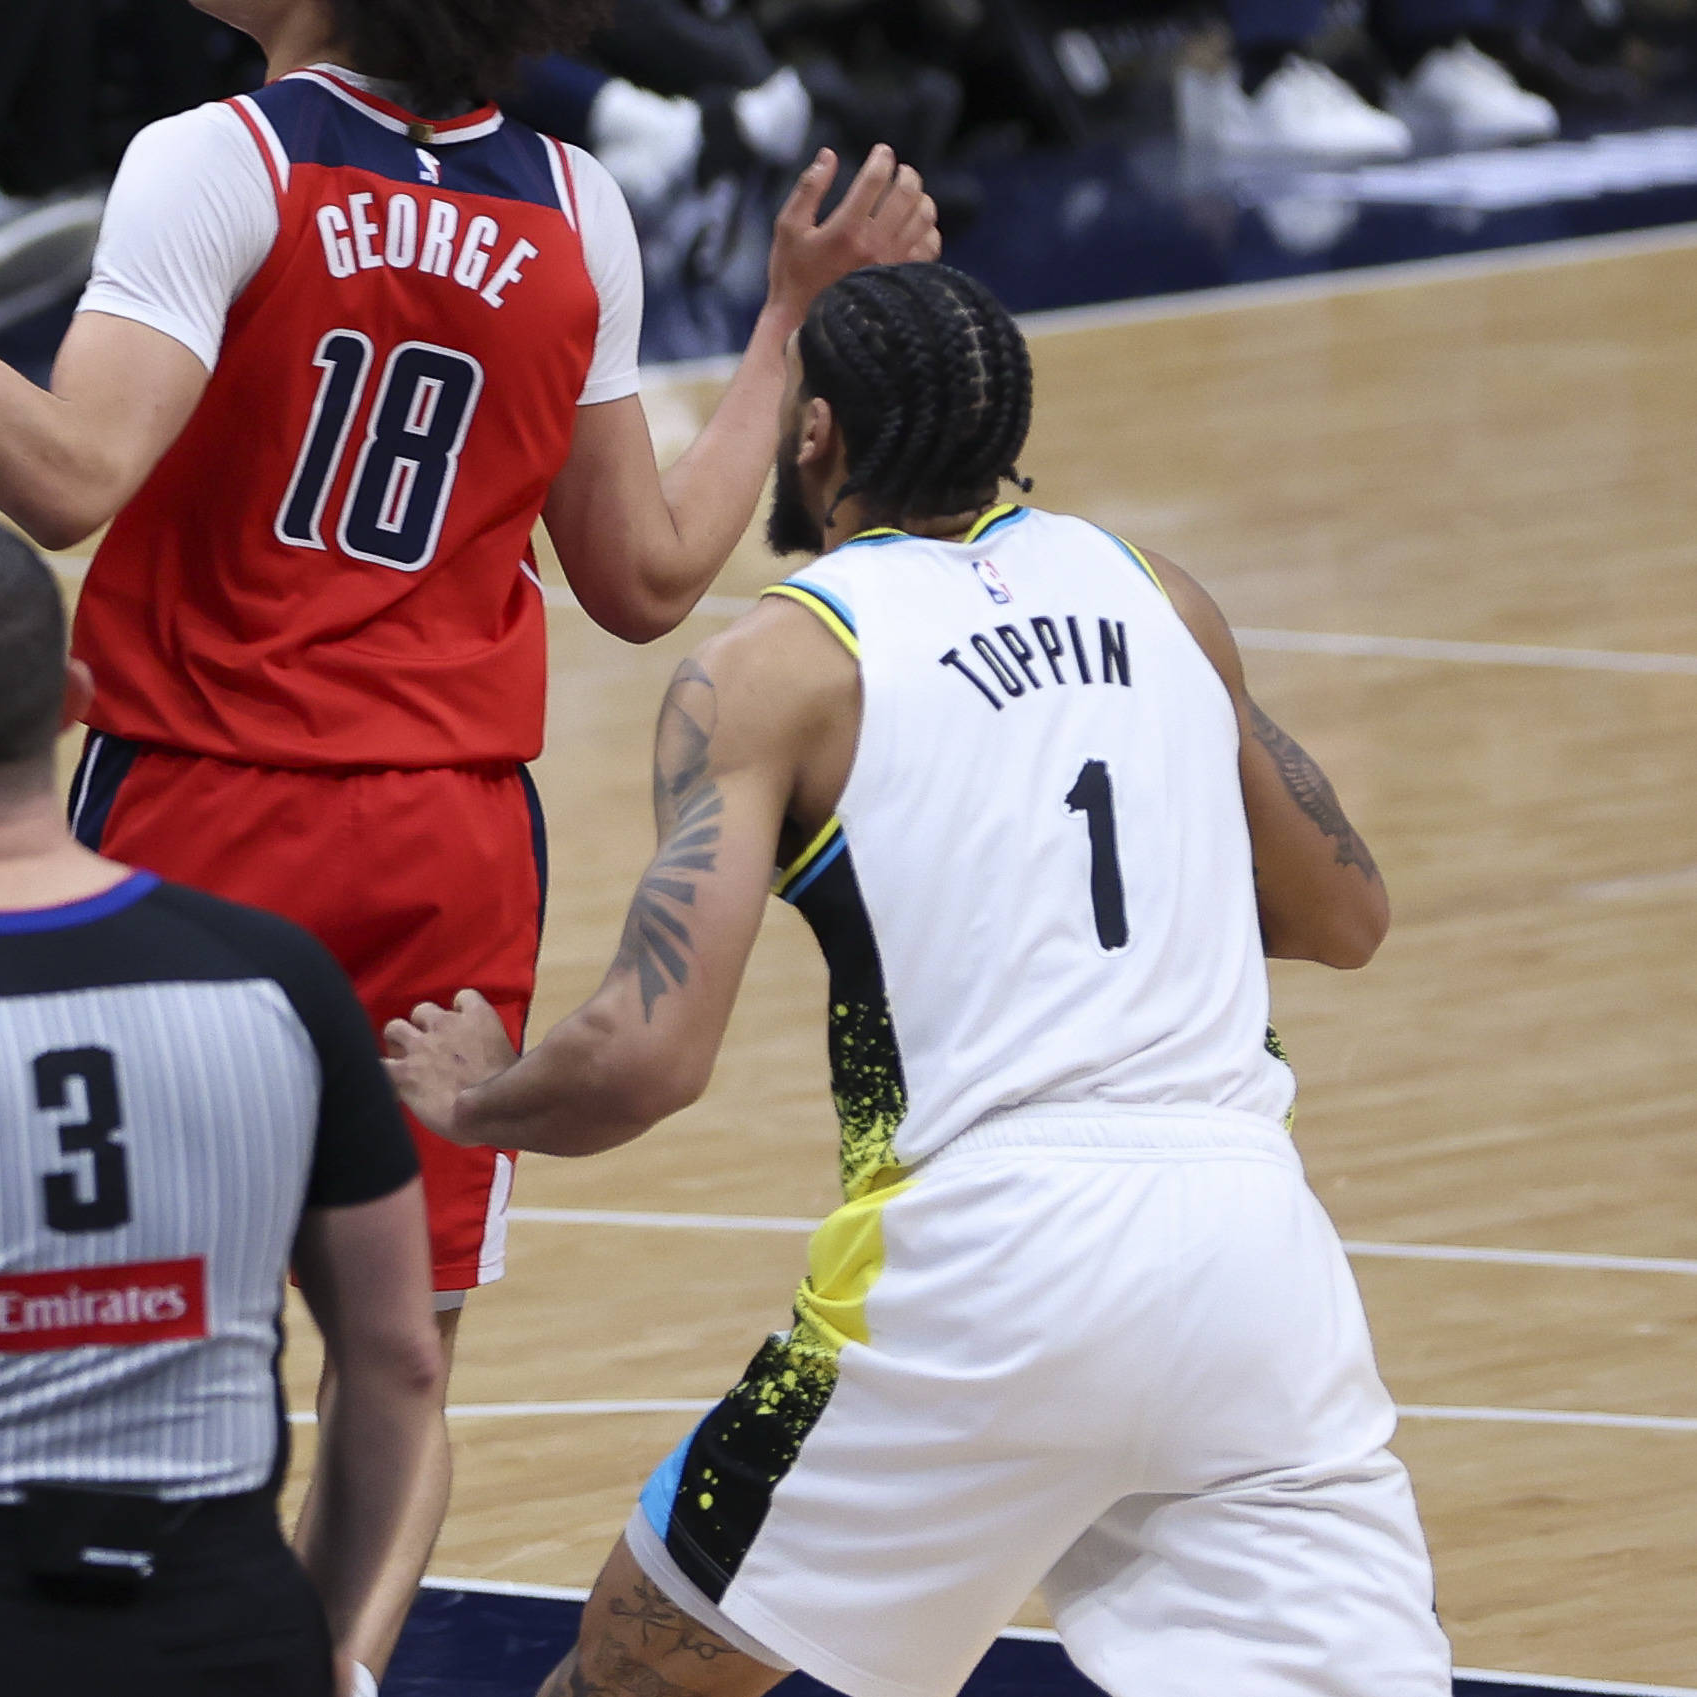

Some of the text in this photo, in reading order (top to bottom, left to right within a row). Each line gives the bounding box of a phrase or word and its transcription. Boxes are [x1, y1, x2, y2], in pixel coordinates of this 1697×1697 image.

[316, 191, 539, 309] GEORGE
[274, 328, 484, 572] 18
[939, 615, 1132, 712] TOPPIN
[1064, 758, 1129, 952] 1
[33, 1045, 133, 1234] 3
